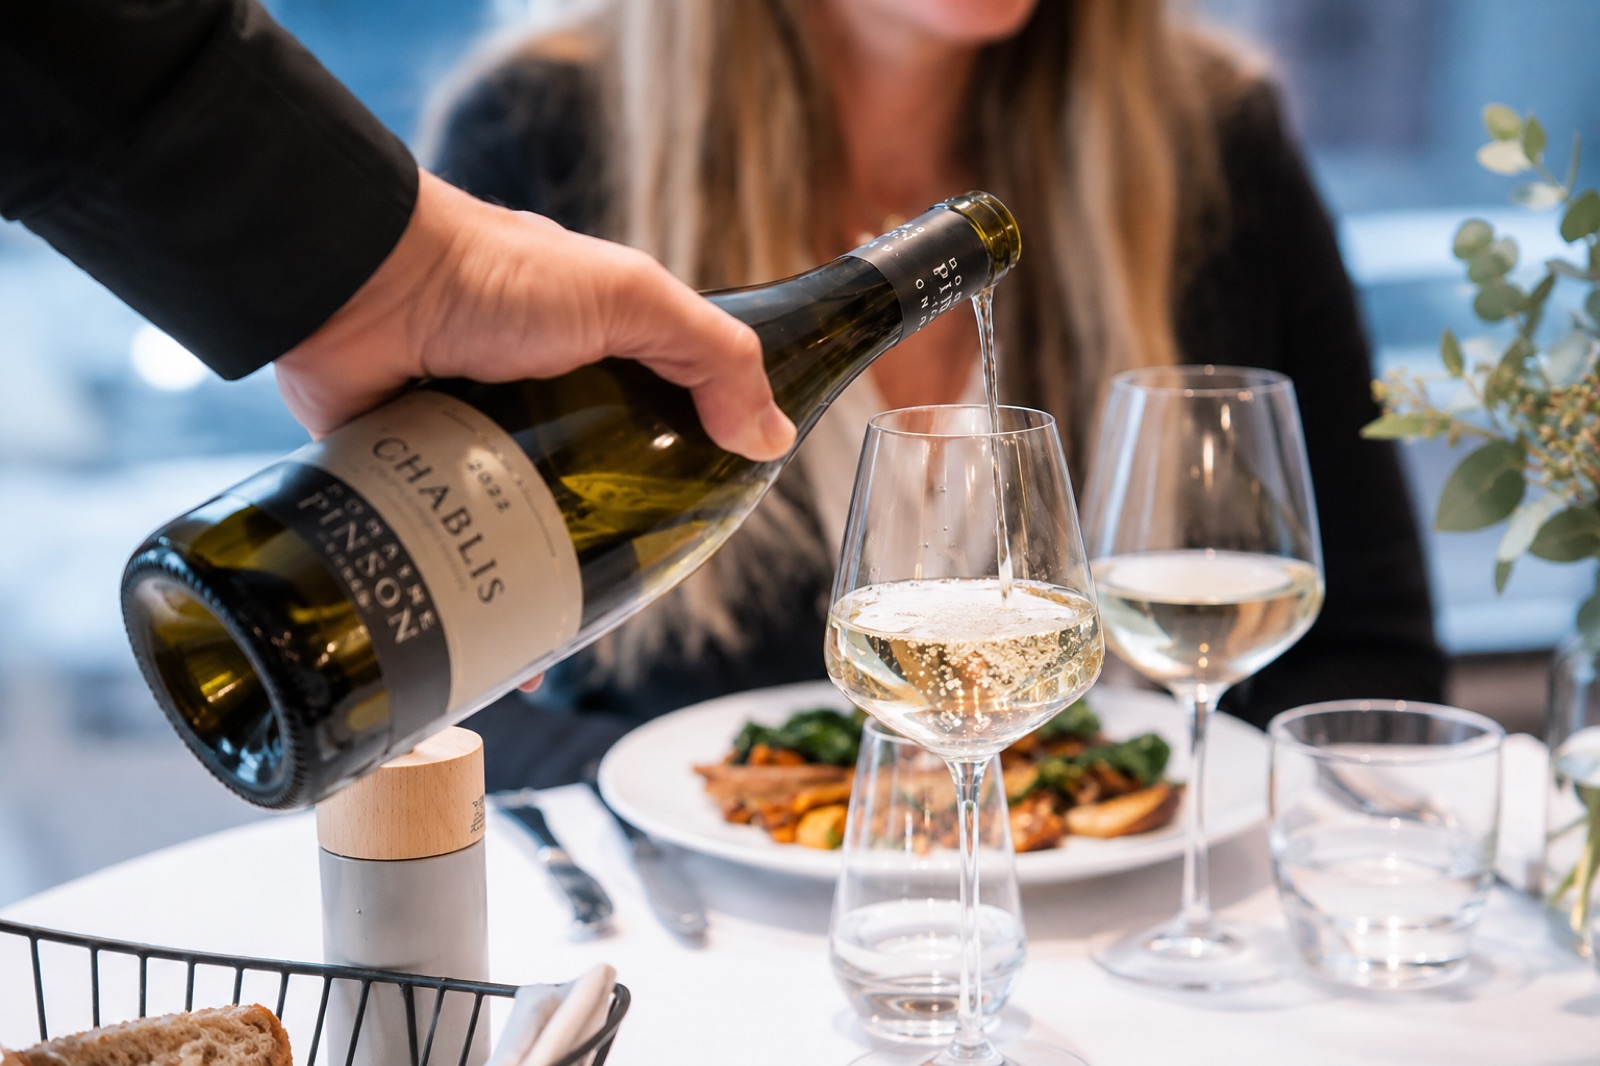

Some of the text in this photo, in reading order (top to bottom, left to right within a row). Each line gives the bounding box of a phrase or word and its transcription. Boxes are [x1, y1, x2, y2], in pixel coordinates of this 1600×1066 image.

[372, 437, 505, 605] CHABLIS
[468, 460, 511, 512] 2022
[297, 491, 420, 644] PINSON
